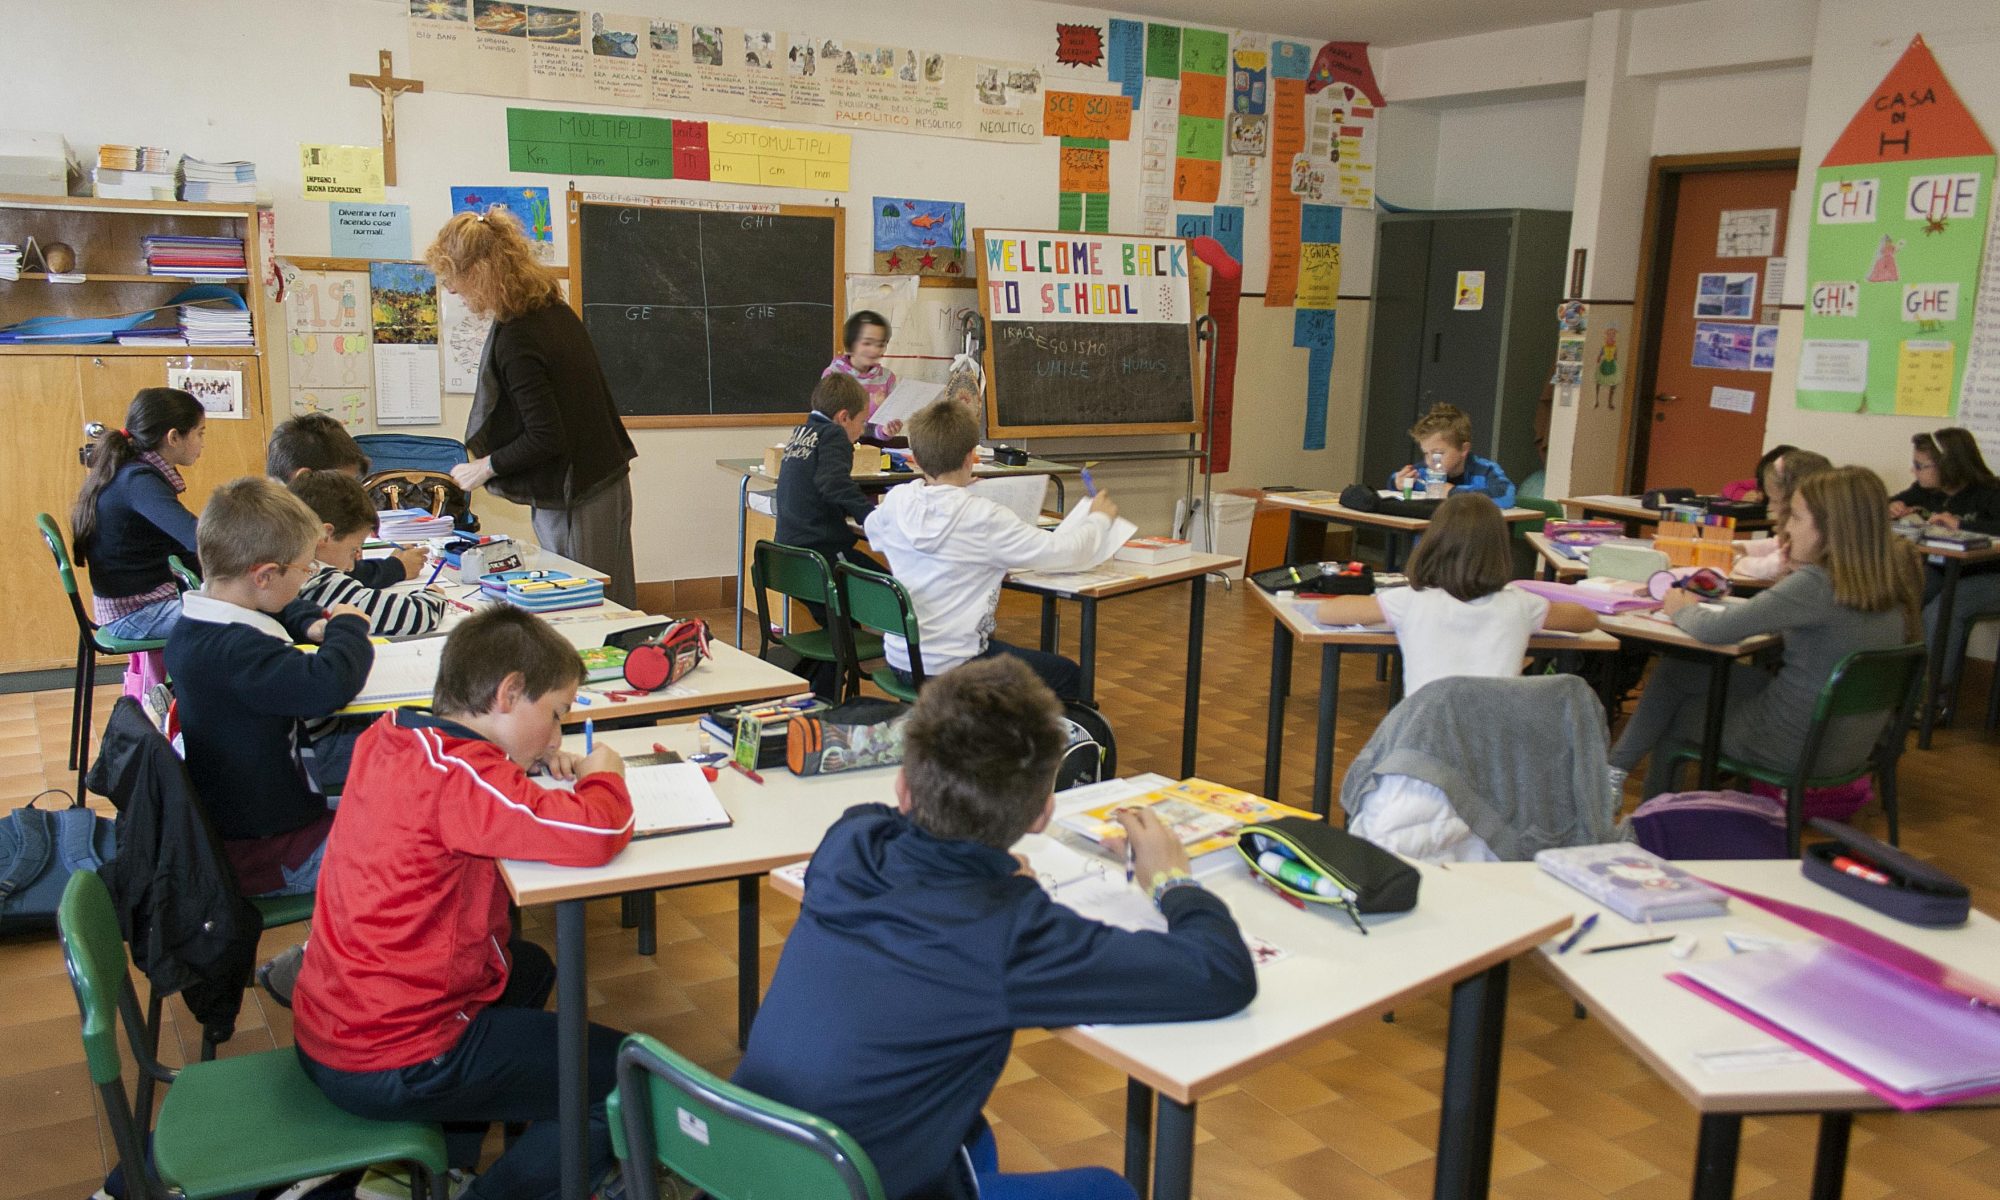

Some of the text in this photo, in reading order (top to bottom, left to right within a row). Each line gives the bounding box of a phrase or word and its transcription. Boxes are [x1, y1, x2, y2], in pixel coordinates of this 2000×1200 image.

[416, 31, 457, 41] BIG BANG
[611, 72, 642, 81] ARCAICA
[1049, 95, 1075, 113] SCE
[1873, 87, 1937, 112] CASA
[835, 110, 909, 126] PALEOLITICO
[914, 106, 939, 117] UOMO
[559, 116, 642, 140] MULTIPLI
[915, 117, 962, 130] MESOLITICO
[980, 121, 1035, 136] NEOLITICO
[721, 130, 832, 156] SOTTOMULTIPLI
[1878, 129, 1910, 156] H
[526, 145, 548, 168] Km
[586, 147, 605, 168] hm
[635, 151, 660, 169] dam
[713, 159, 733, 173] dm
[769, 165, 785, 176] cm
[814, 168, 832, 179] mm
[306, 175, 332, 184] IMPEGNO
[306, 184, 362, 195] BUONA EDUCAZIONE
[1822, 178, 1975, 218] CHI CHE
[338, 208, 397, 218] Diventare forti
[339, 218, 392, 227] facendo cose
[740, 215, 773, 230] GHI
[986, 239, 1188, 278] WELCOME BACK
[1310, 247, 1331, 259] GNIA
[988, 280, 1138, 315] TO SCHOOL
[1813, 286, 1847, 310] GHI
[1906, 289, 1949, 314] GHE
[625, 306, 651, 321] GE
[745, 306, 777, 319] GHE
[1003, 326, 1036, 340] IRAQ
[1037, 358, 1168, 379] UMILE HUMUS
